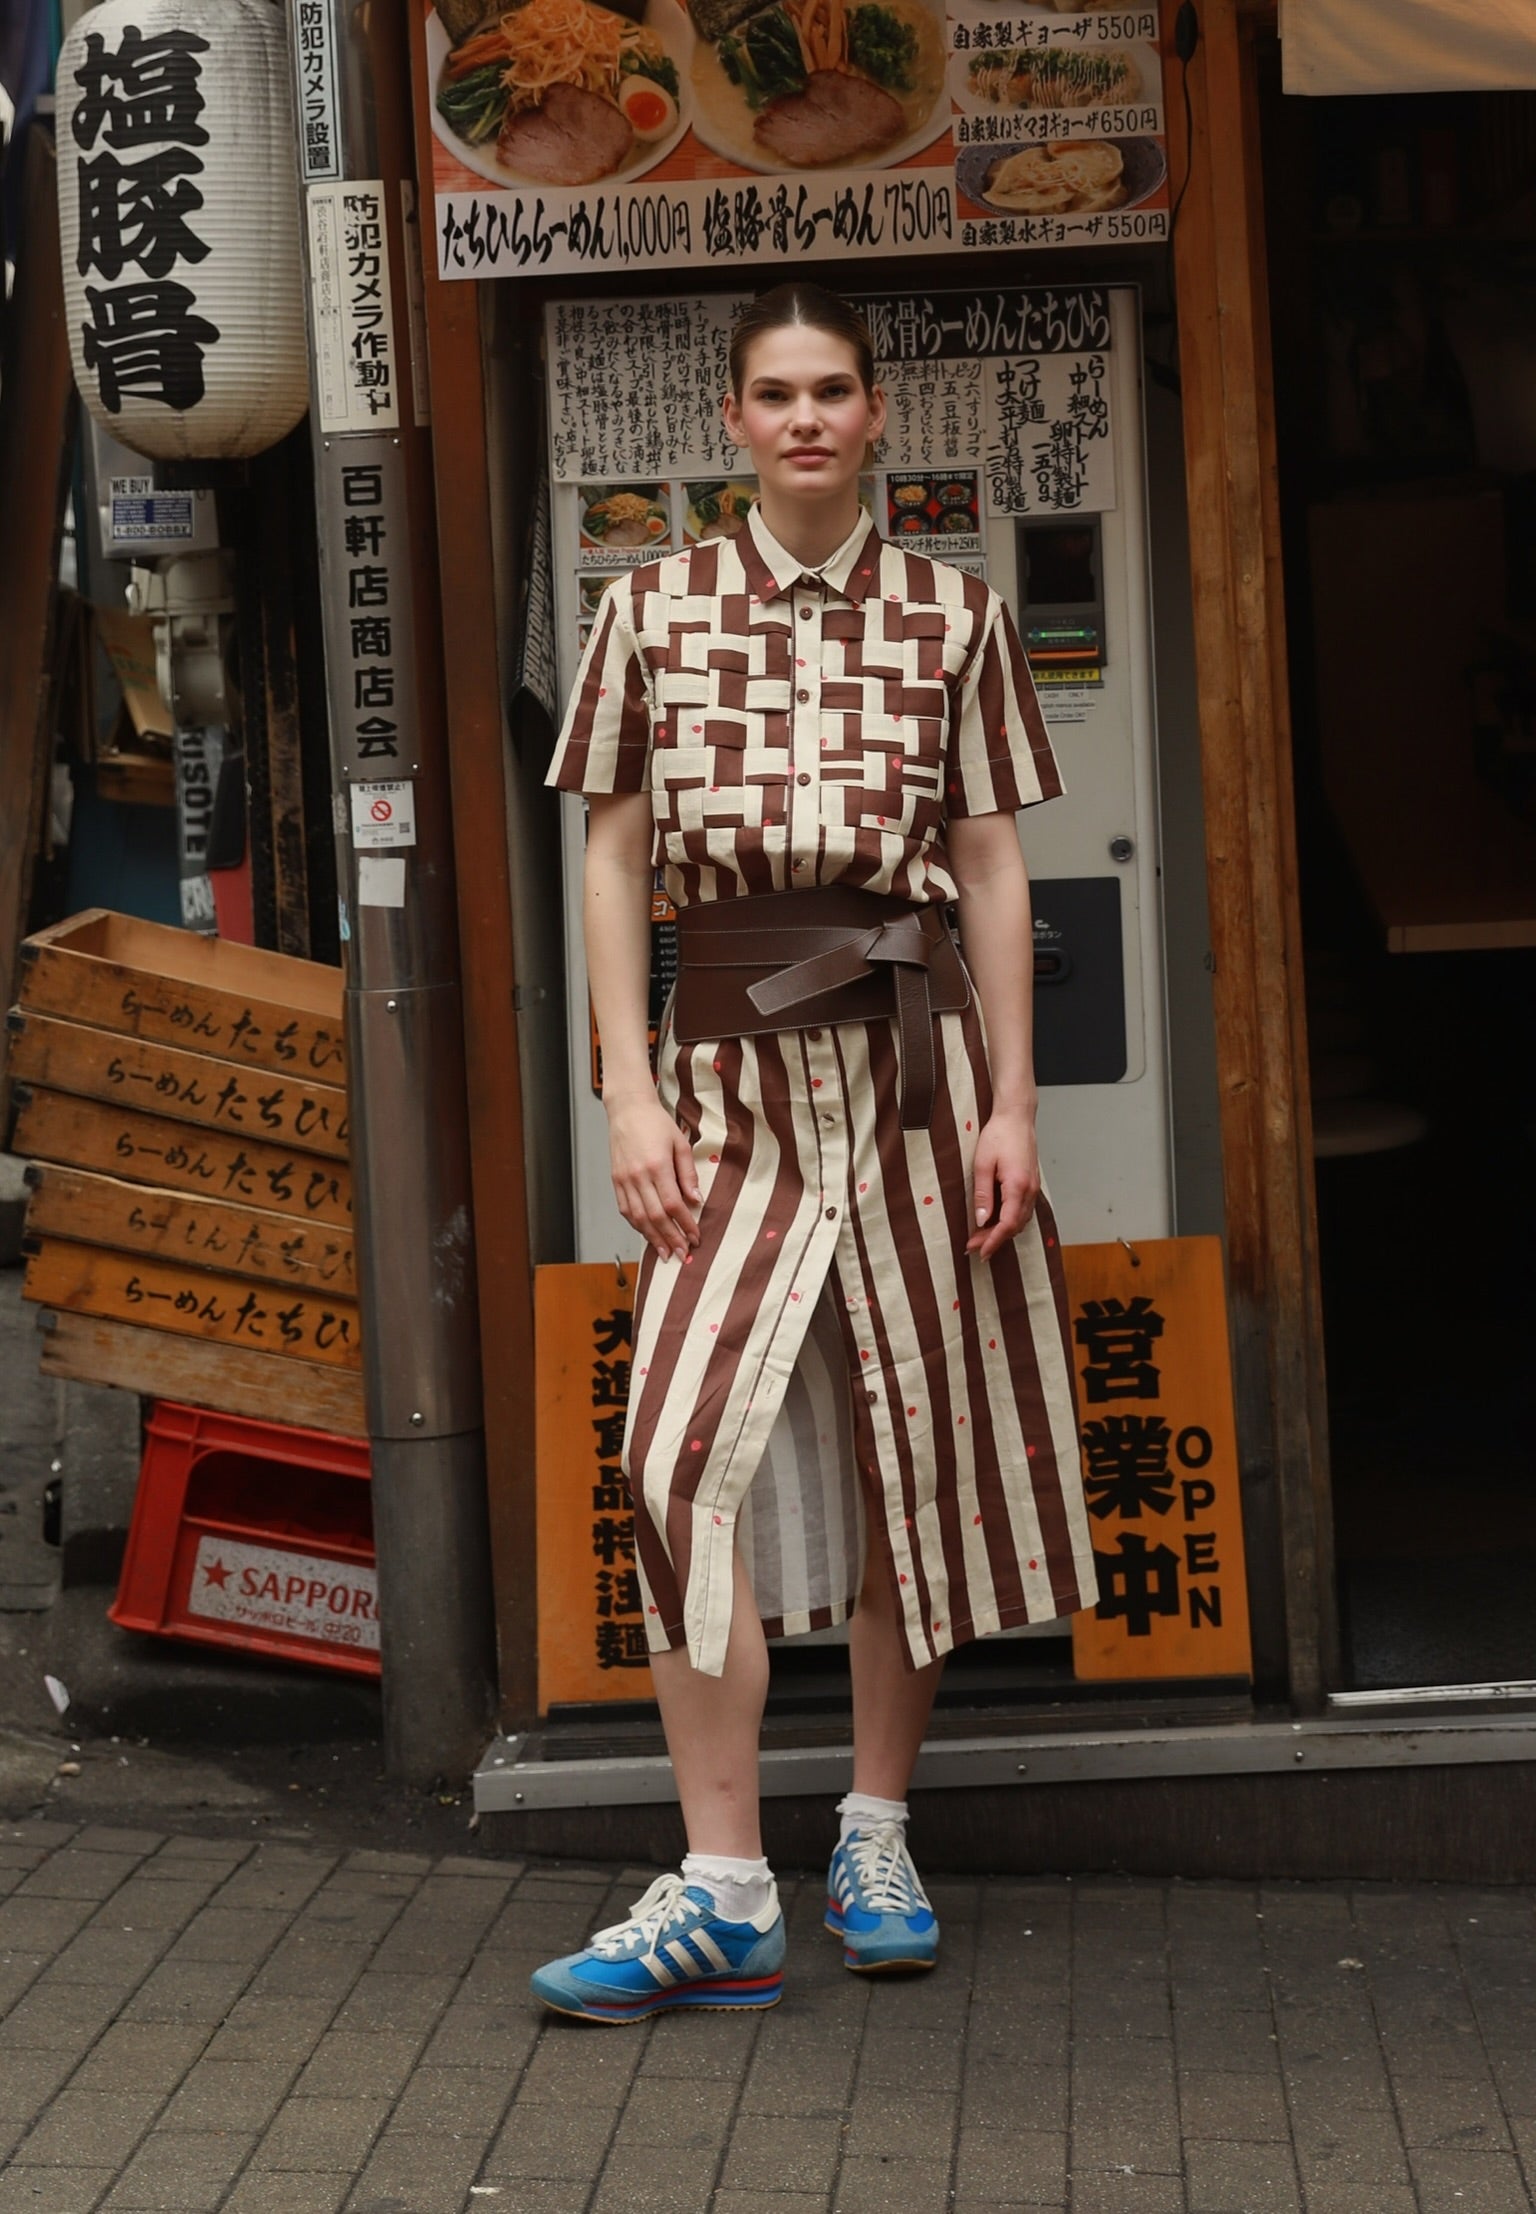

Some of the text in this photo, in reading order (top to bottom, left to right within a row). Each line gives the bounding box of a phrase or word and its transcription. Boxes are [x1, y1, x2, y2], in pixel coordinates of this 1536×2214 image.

[300, 2, 331, 170] 防犯カメラ設置
[71, 25, 220, 413] 塩豚骨
[343, 193, 392, 416] 防犯カメラ作動中
[1015, 358, 1050, 425] つけ麺
[1087, 355, 1109, 441] らーめん
[341, 464, 398, 759] 百軒店商店会
[107, 1057, 207, 1108] らーめん
[116, 1132, 353, 1213] らーめん たちひ
[125, 1277, 227, 1321] らーめん
[1072, 1295, 1181, 1637] 営業中
[1175, 1425, 1223, 1629] OPEN
[238, 1566, 380, 1621] SAPPOR
